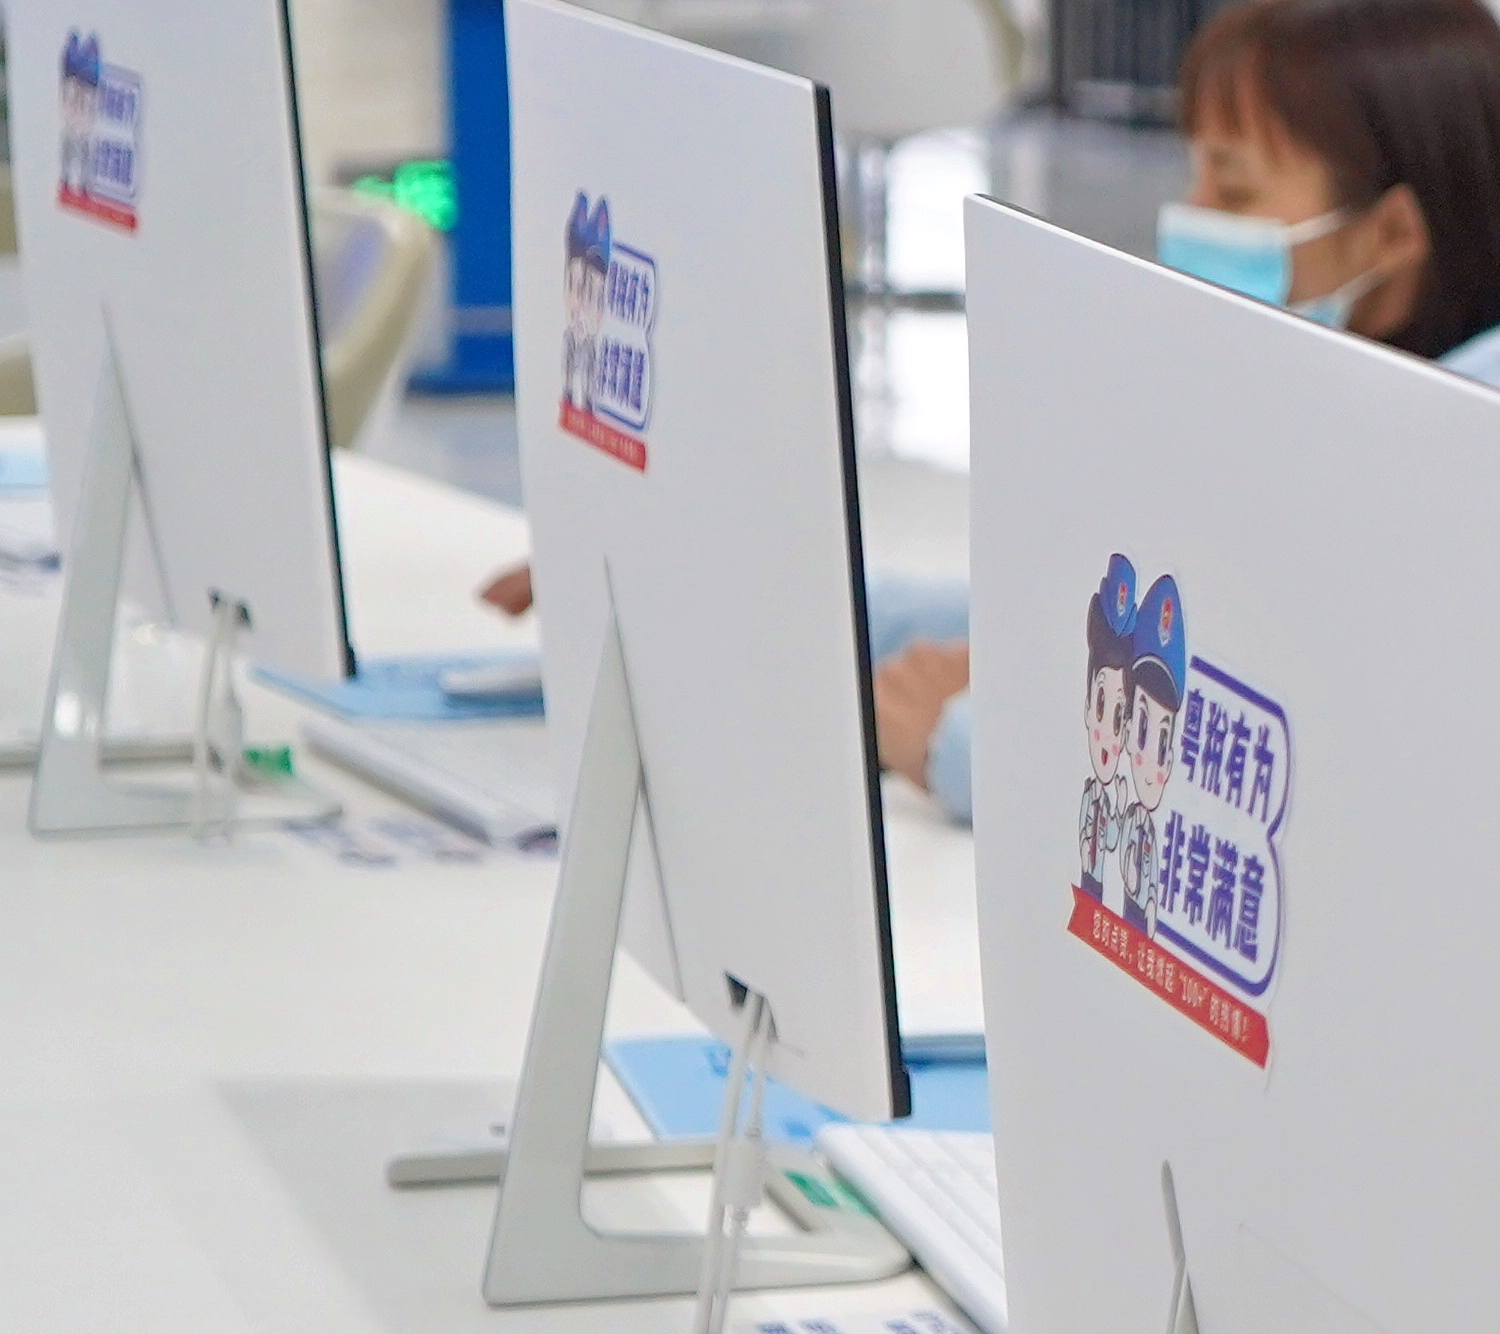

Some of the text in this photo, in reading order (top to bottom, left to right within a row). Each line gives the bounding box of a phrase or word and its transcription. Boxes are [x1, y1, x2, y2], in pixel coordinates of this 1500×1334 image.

[1181, 687, 1275, 824] 粤税有为
[1159, 809, 1266, 964] 非常满意
